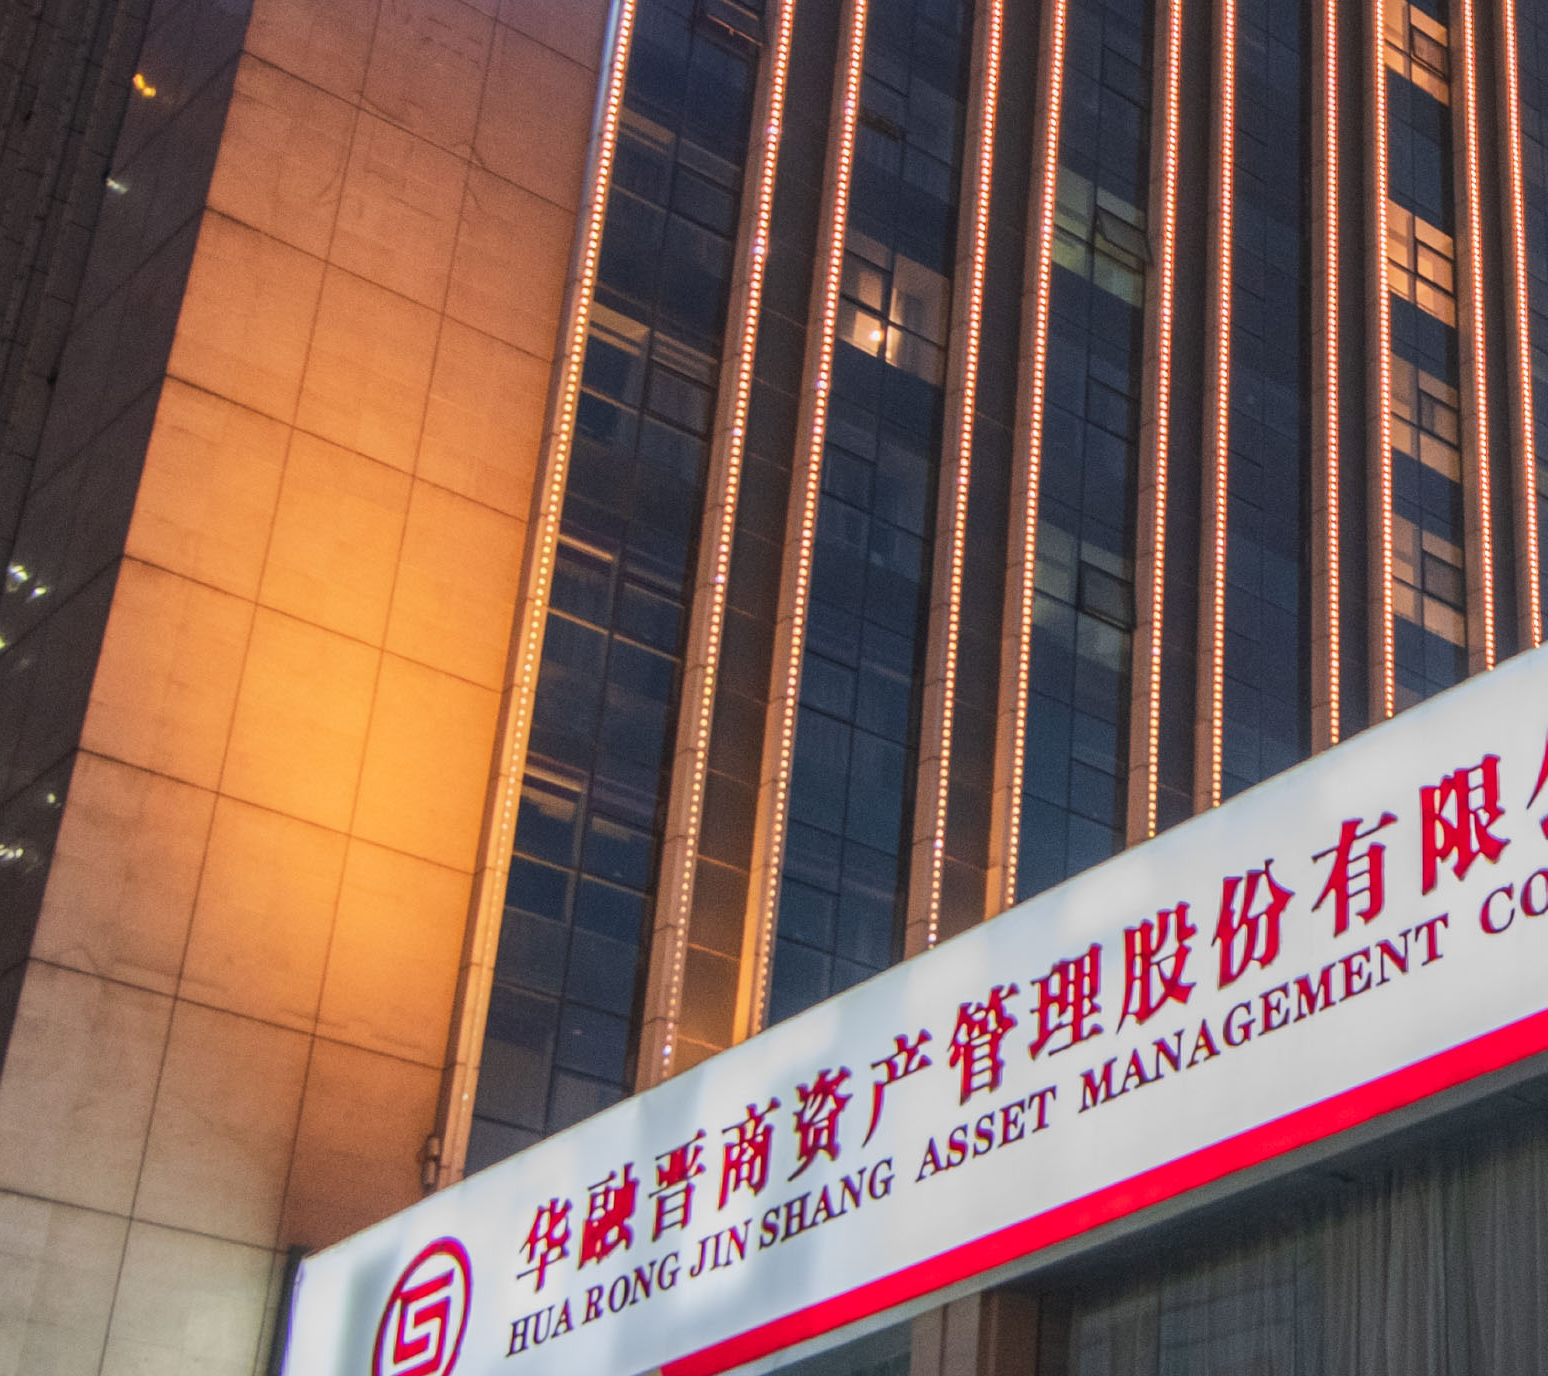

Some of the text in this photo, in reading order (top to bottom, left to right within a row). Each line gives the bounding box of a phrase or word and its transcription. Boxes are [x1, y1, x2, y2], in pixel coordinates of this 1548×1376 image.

[505, 1307, 574, 1358] HUA
[582, 1253, 680, 1327] RONG
[688, 1224, 755, 1279] JIN
[757, 1156, 896, 1250] SHANG
[915, 1083, 1059, 1183] ASSET
[1077, 911, 1450, 1115] MANAGEMENT
